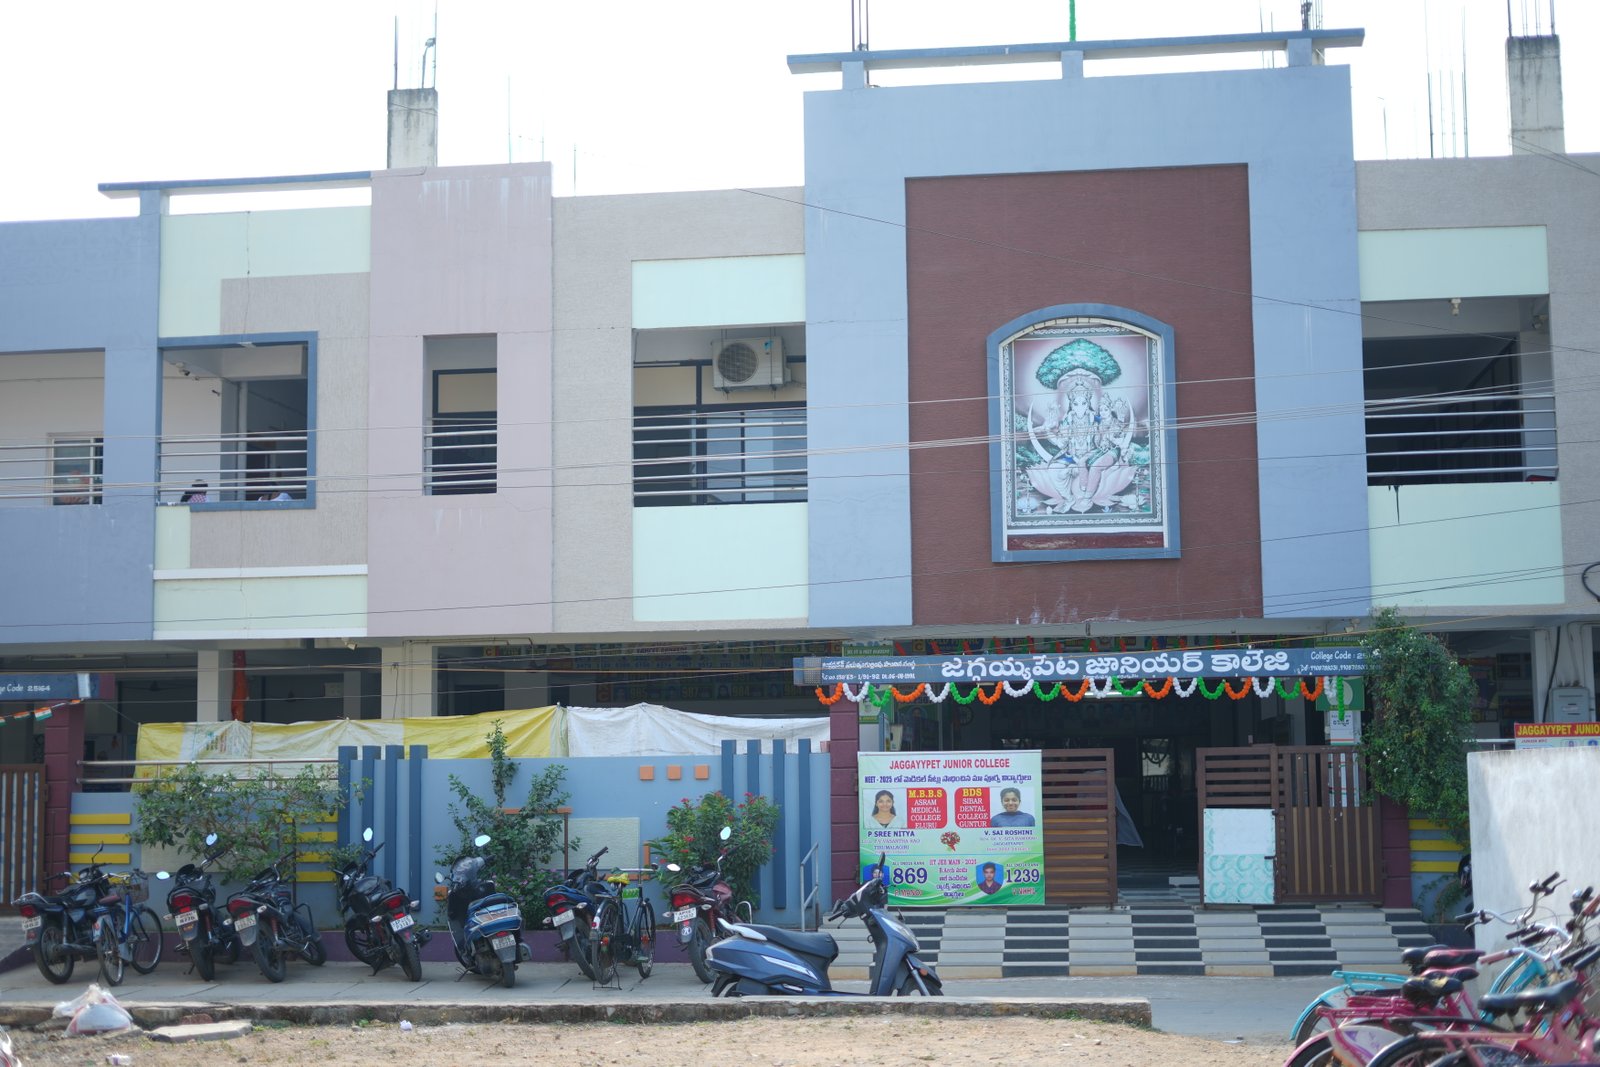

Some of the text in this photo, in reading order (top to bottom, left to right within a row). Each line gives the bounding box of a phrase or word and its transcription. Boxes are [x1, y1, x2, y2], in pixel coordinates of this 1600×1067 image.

[1310, 651, 1333, 662] College
[1334, 650, 1352, 660] Code
[941, 655, 1080, 681] జగ్గయ్యపేట
[1085, 652, 1204, 675] జూనియర్
[6, 684, 23, 692] Code
[1518, 725, 1572, 736] JAGGAYYPET
[890, 758, 1010, 770] JAGGAYYPET JUNIOR COLLEGE
[908, 790, 942, 798] M.B.B.S
[962, 788, 982, 796] BDS
[892, 868, 928, 884] 869
[1006, 868, 1040, 882] 1239
